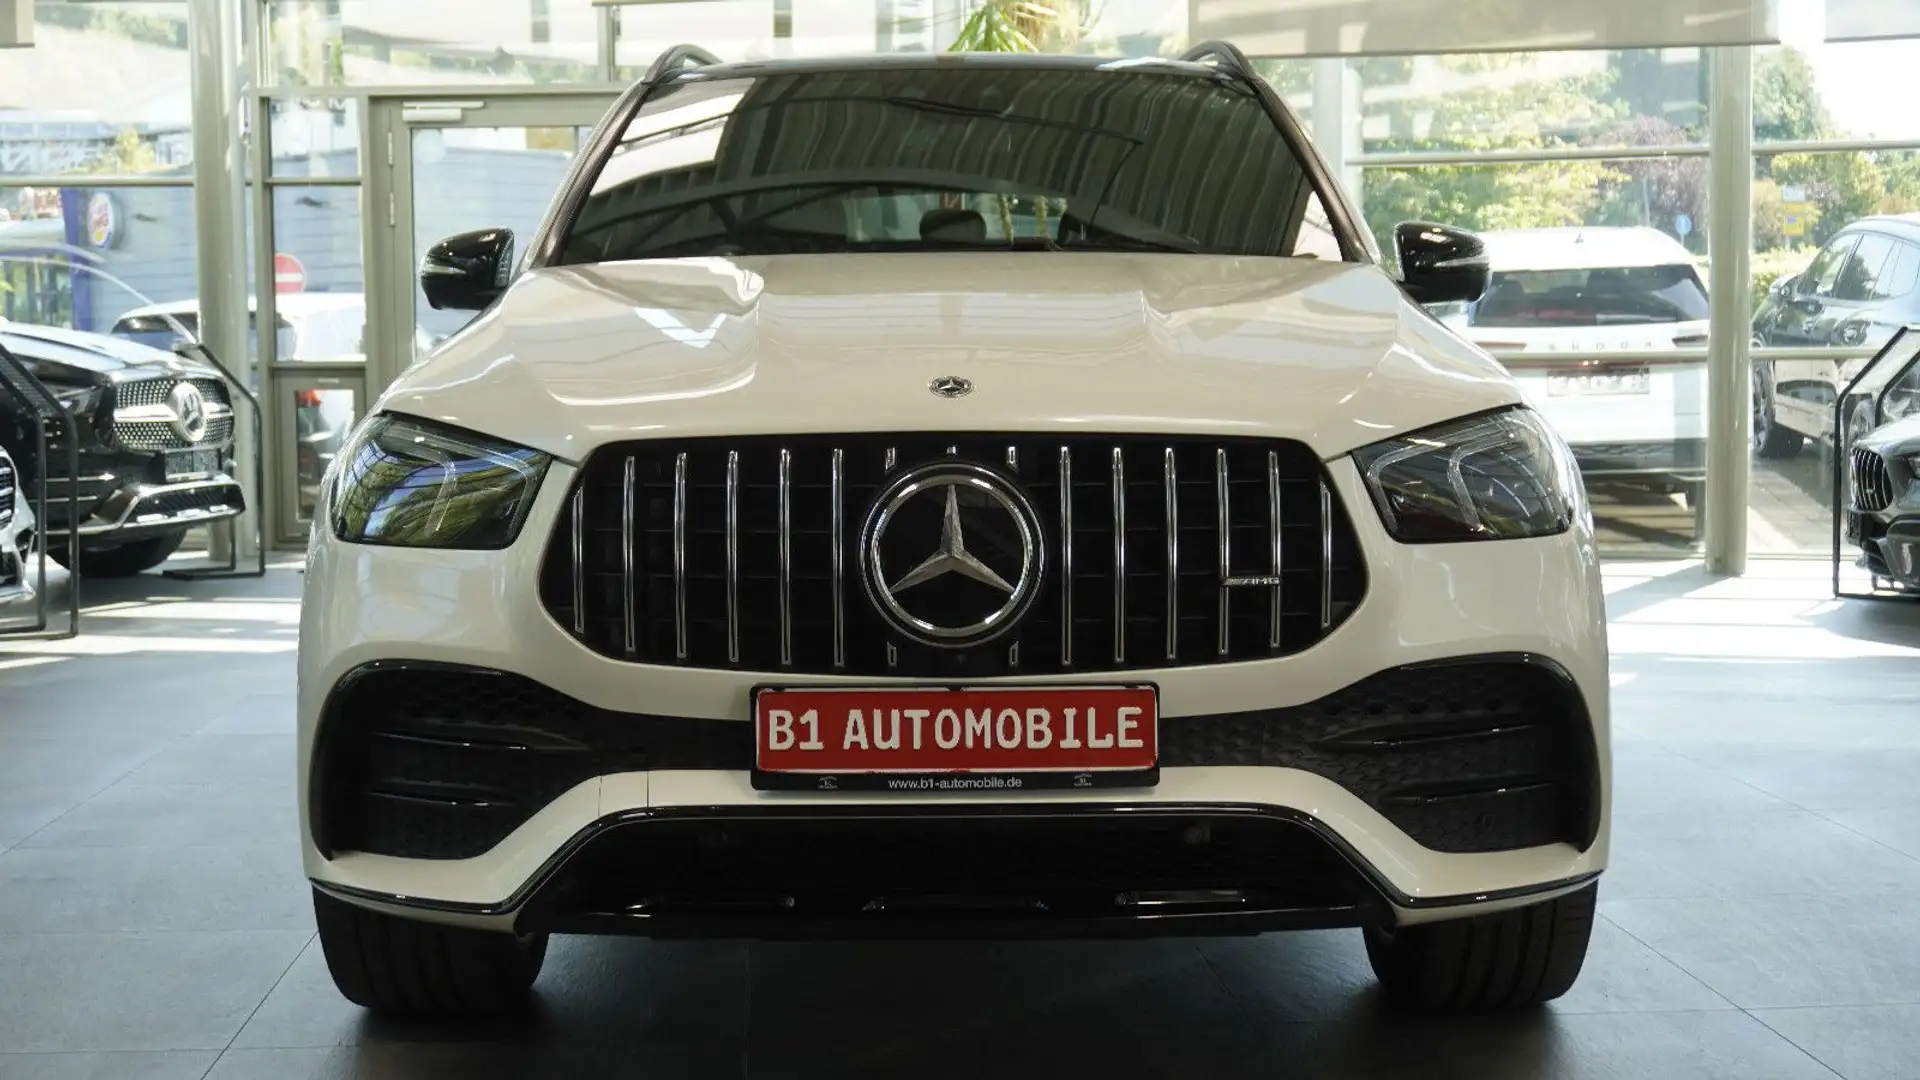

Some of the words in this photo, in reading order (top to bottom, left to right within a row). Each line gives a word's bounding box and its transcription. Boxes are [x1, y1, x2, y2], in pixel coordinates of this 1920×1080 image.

[768, 709, 824, 750] B1
[842, 707, 1144, 750] AUTOMOBILE
[888, 777, 1022, 789] www.b1-automobile.de
